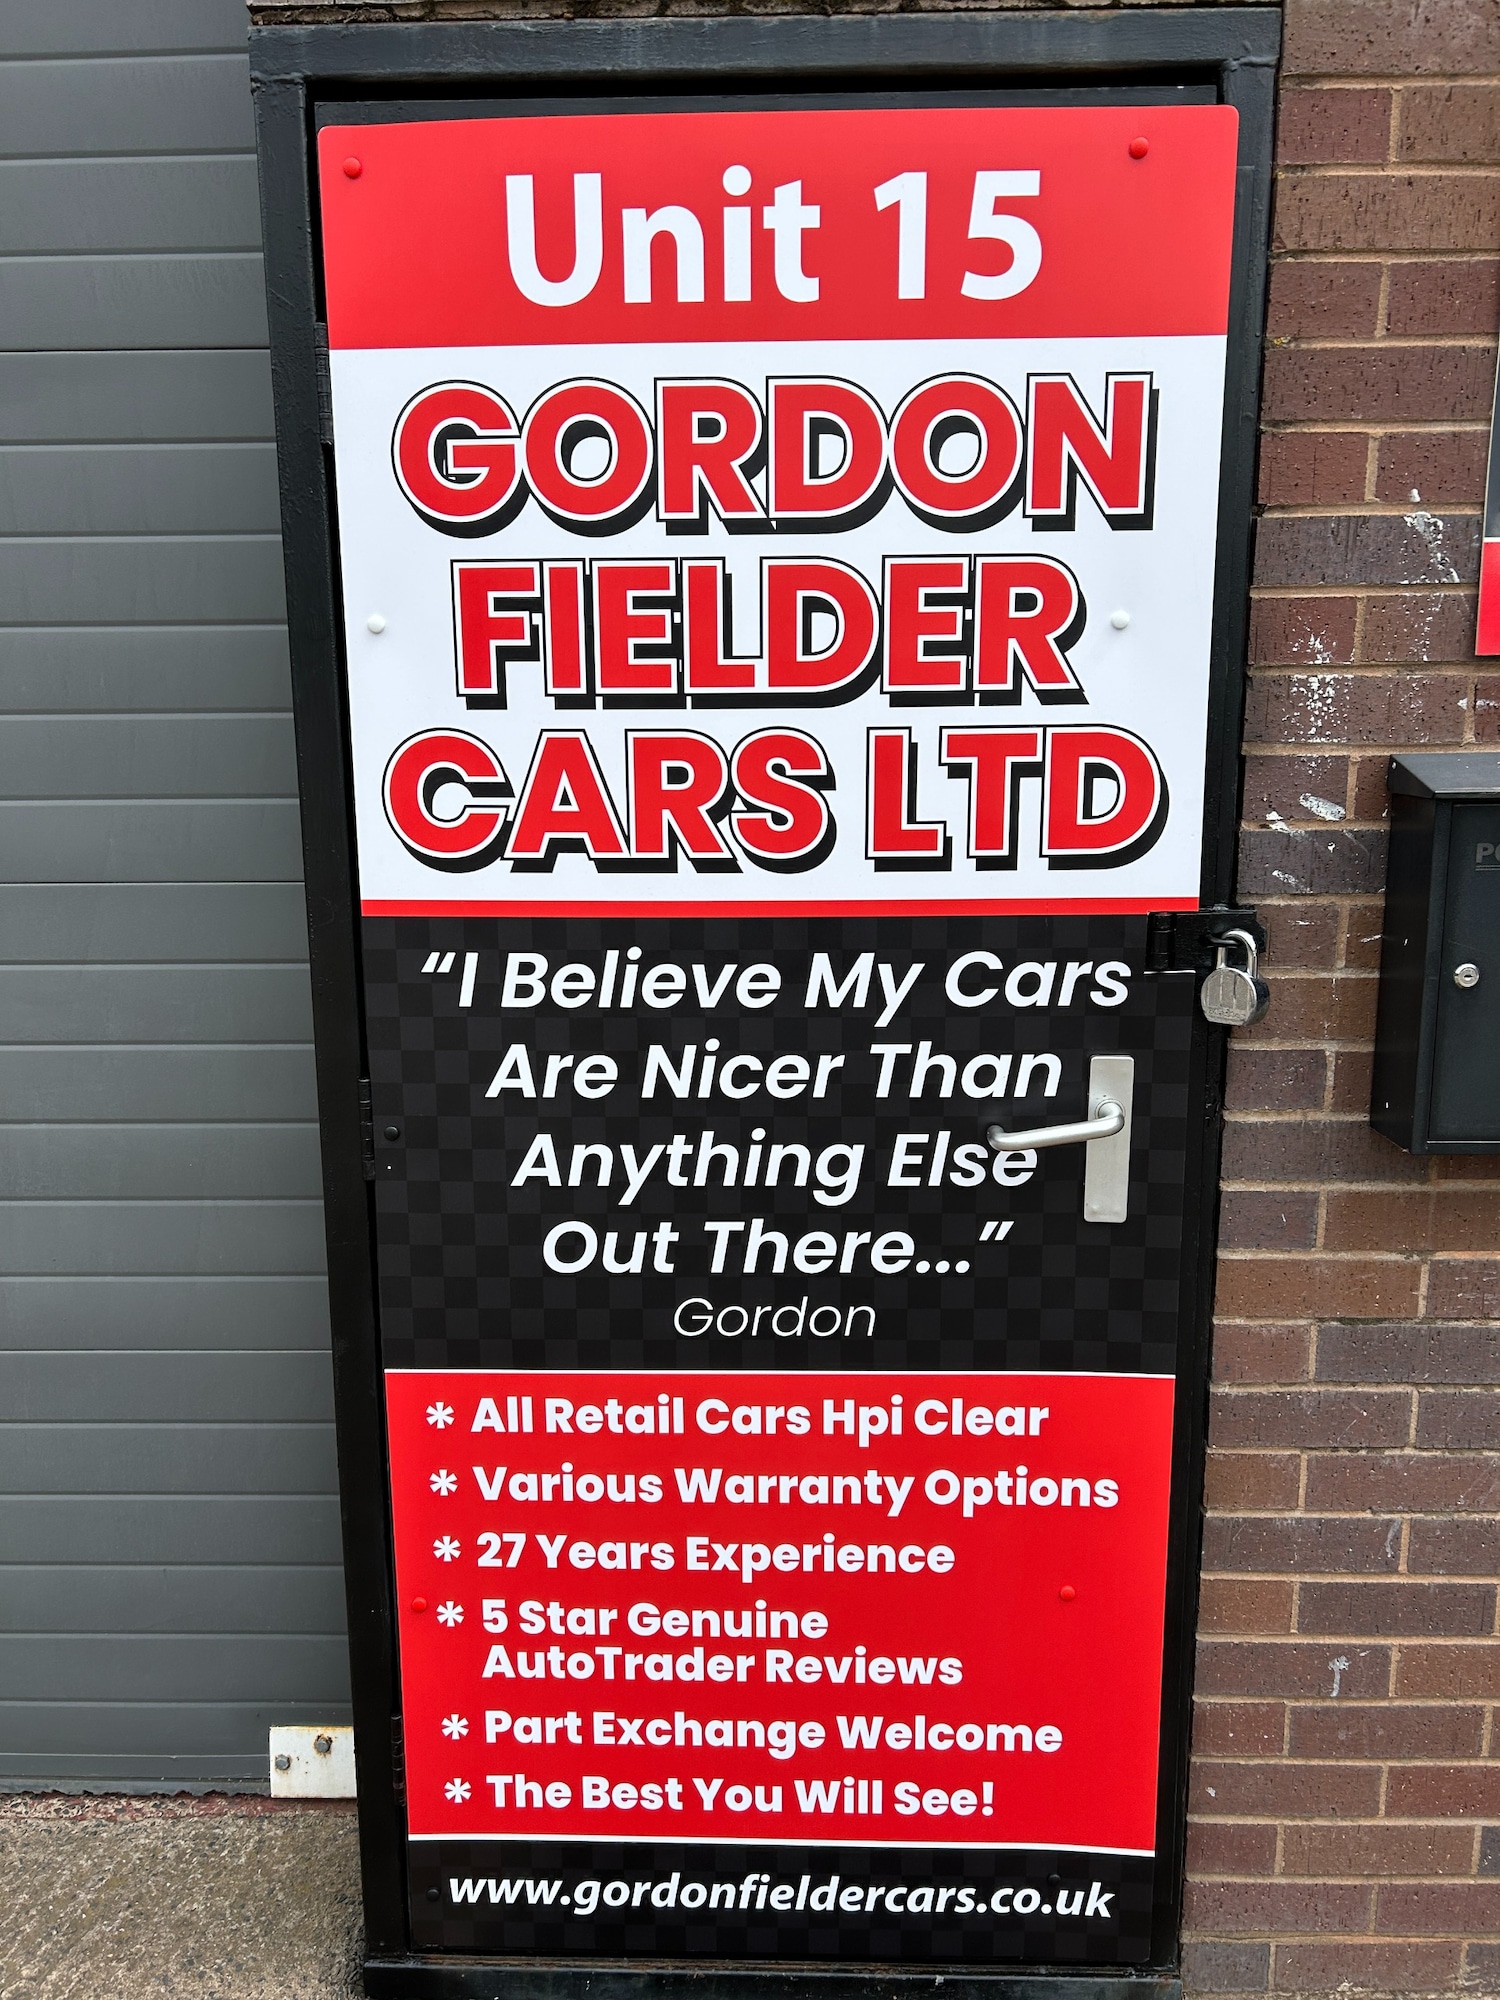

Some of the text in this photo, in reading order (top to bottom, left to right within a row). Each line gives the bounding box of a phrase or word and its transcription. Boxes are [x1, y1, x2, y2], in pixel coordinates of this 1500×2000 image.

[506, 165, 1042, 306] Unit 15
[391, 372, 1159, 538] GORDON
[450, 554, 1089, 710] FIELDER
[382, 724, 1169, 874] CARS LTD
[501, 947, 781, 1008] Believe
[805, 953, 925, 1027] My
[945, 951, 1131, 1007] Cars
[485, 1038, 1061, 1099] Are Nicer Than
[511, 1128, 1038, 1206] Anything Else
[543, 1221, 679, 1273] Out
[674, 1296, 875, 1336] Gordon
[471, 1394, 1049, 1447] All Retail Cars Hpi Clear
[473, 1462, 1118, 1517] Various Warranty Options
[477, 1532, 955, 1583] 27 Years Experience
[483, 1599, 828, 1638] 5 Star Genuine
[482, 1645, 962, 1684] AutoTrader Reviews
[486, 1711, 1062, 1759] Part Exchange Welcome
[486, 1774, 993, 1816] The Best You Will See!
[450, 1872, 1115, 1917] www.gordonfieldercars.co.uk
